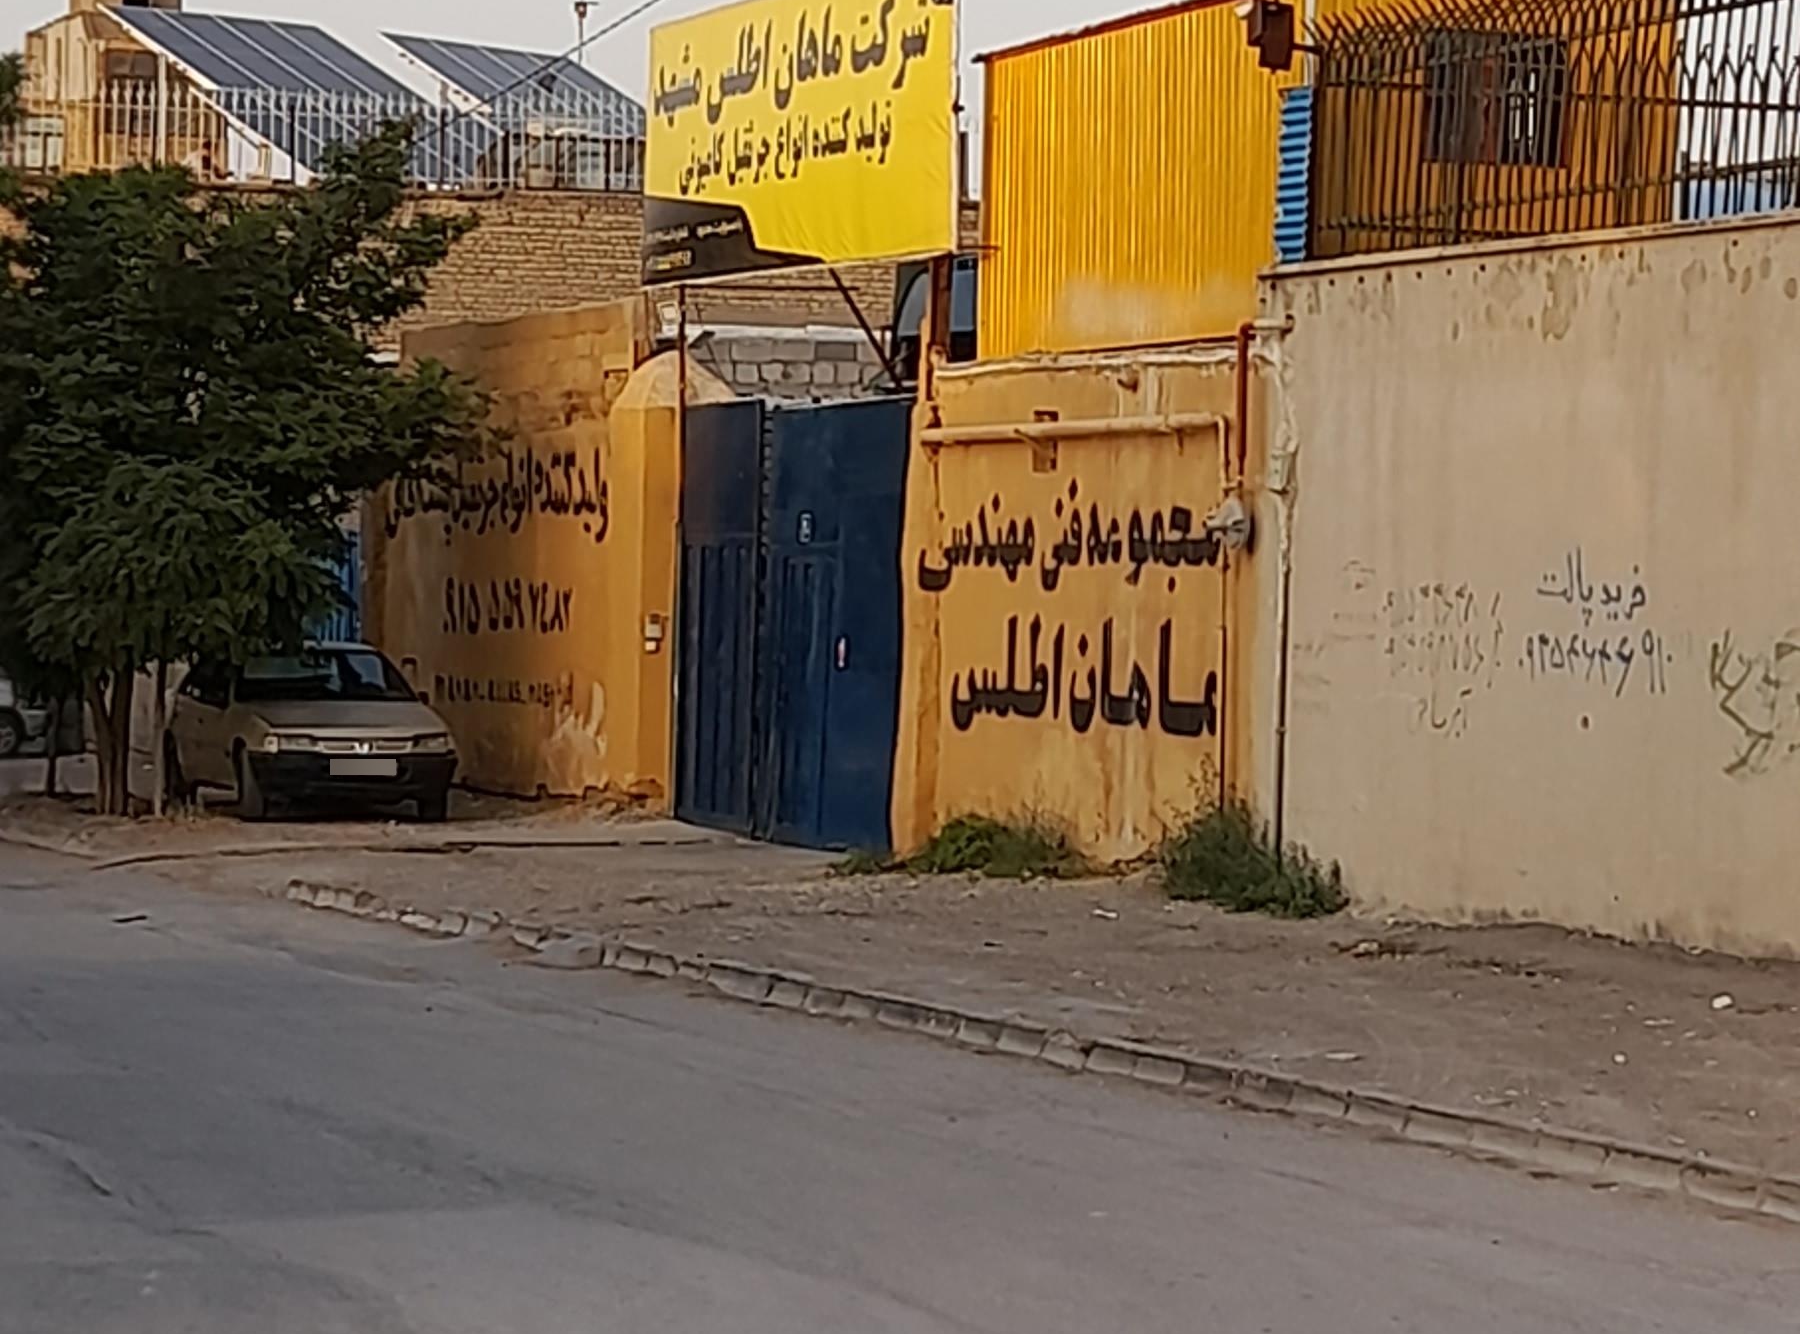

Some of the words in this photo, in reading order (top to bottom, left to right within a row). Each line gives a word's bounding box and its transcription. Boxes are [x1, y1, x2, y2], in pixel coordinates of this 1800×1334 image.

[653, 43, 702, 128] مشهد
[707, 19, 771, 125] اطلس
[775, 4, 843, 110] ماهان
[727, 119, 770, 186] جرثقیل
[775, 114, 809, 179] انواع
[813, 107, 851, 157] کننده
[856, 100, 891, 164] تولید
[918, 493, 1035, 592] مهندسی
[1040, 478, 1083, 592] فنی
[1537, 546, 1594, 627] پالت
[951, 612, 1064, 731] اطلس
[1066, 617, 1216, 737] ماهان
